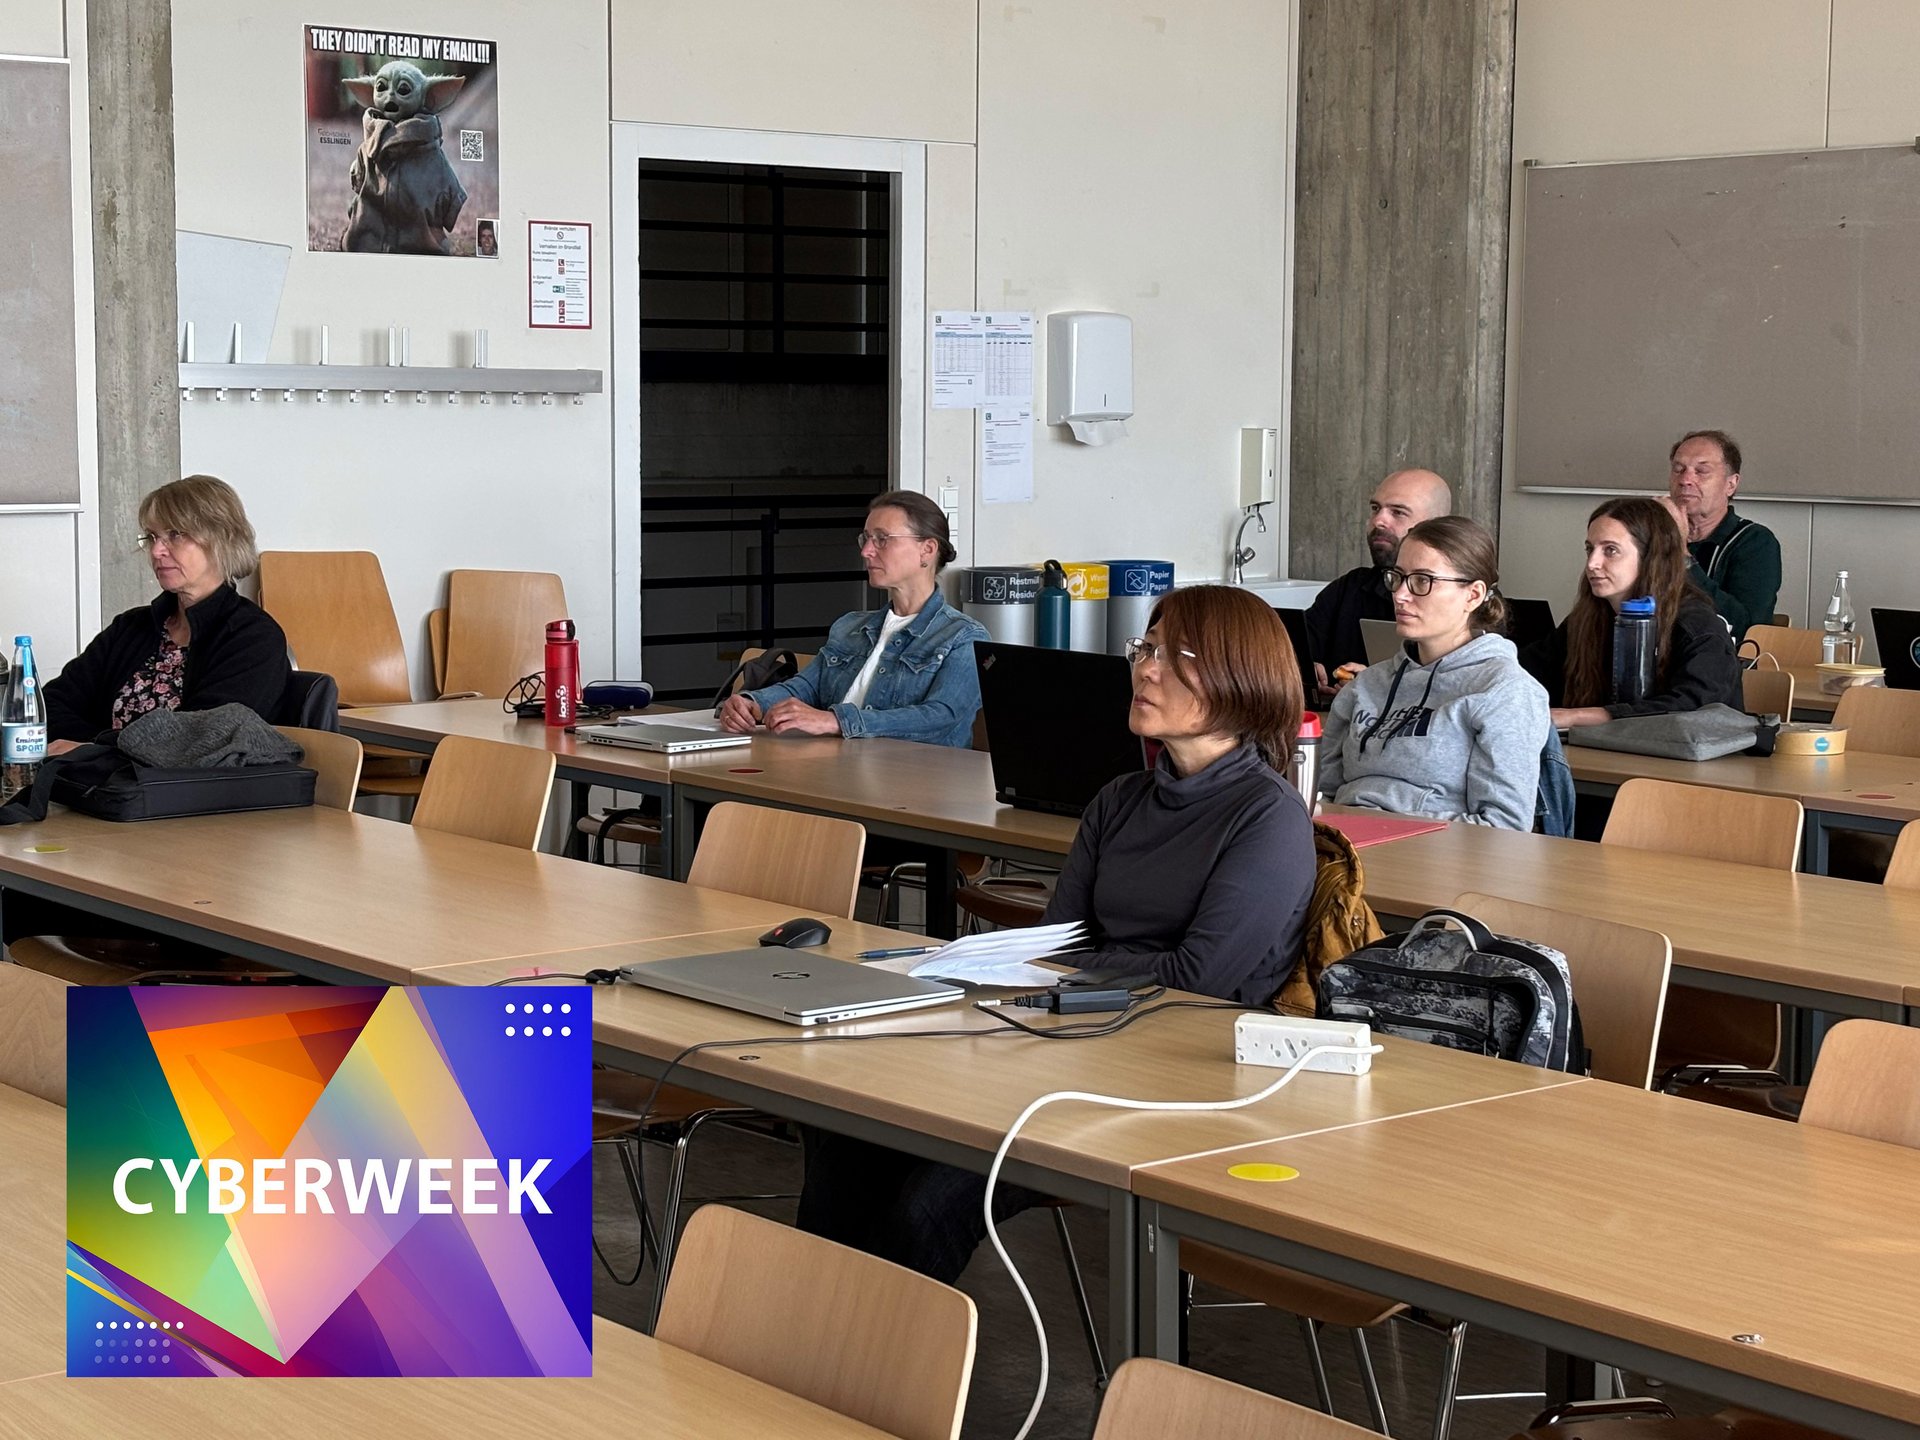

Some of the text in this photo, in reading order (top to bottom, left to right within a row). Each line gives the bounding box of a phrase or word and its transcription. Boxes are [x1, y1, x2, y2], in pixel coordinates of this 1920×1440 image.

[310, 28, 490, 64] THEY DIDN'T READ MY EMAIL!!!
[320, 136, 352, 145] ESSLINGEN
[1149, 571, 1170, 580] Papier
[1009, 576, 1040, 586] Restmül
[1149, 583, 1169, 592] Paper
[1009, 590, 1037, 599] Residu
[16, 744, 43, 752] SPORT
